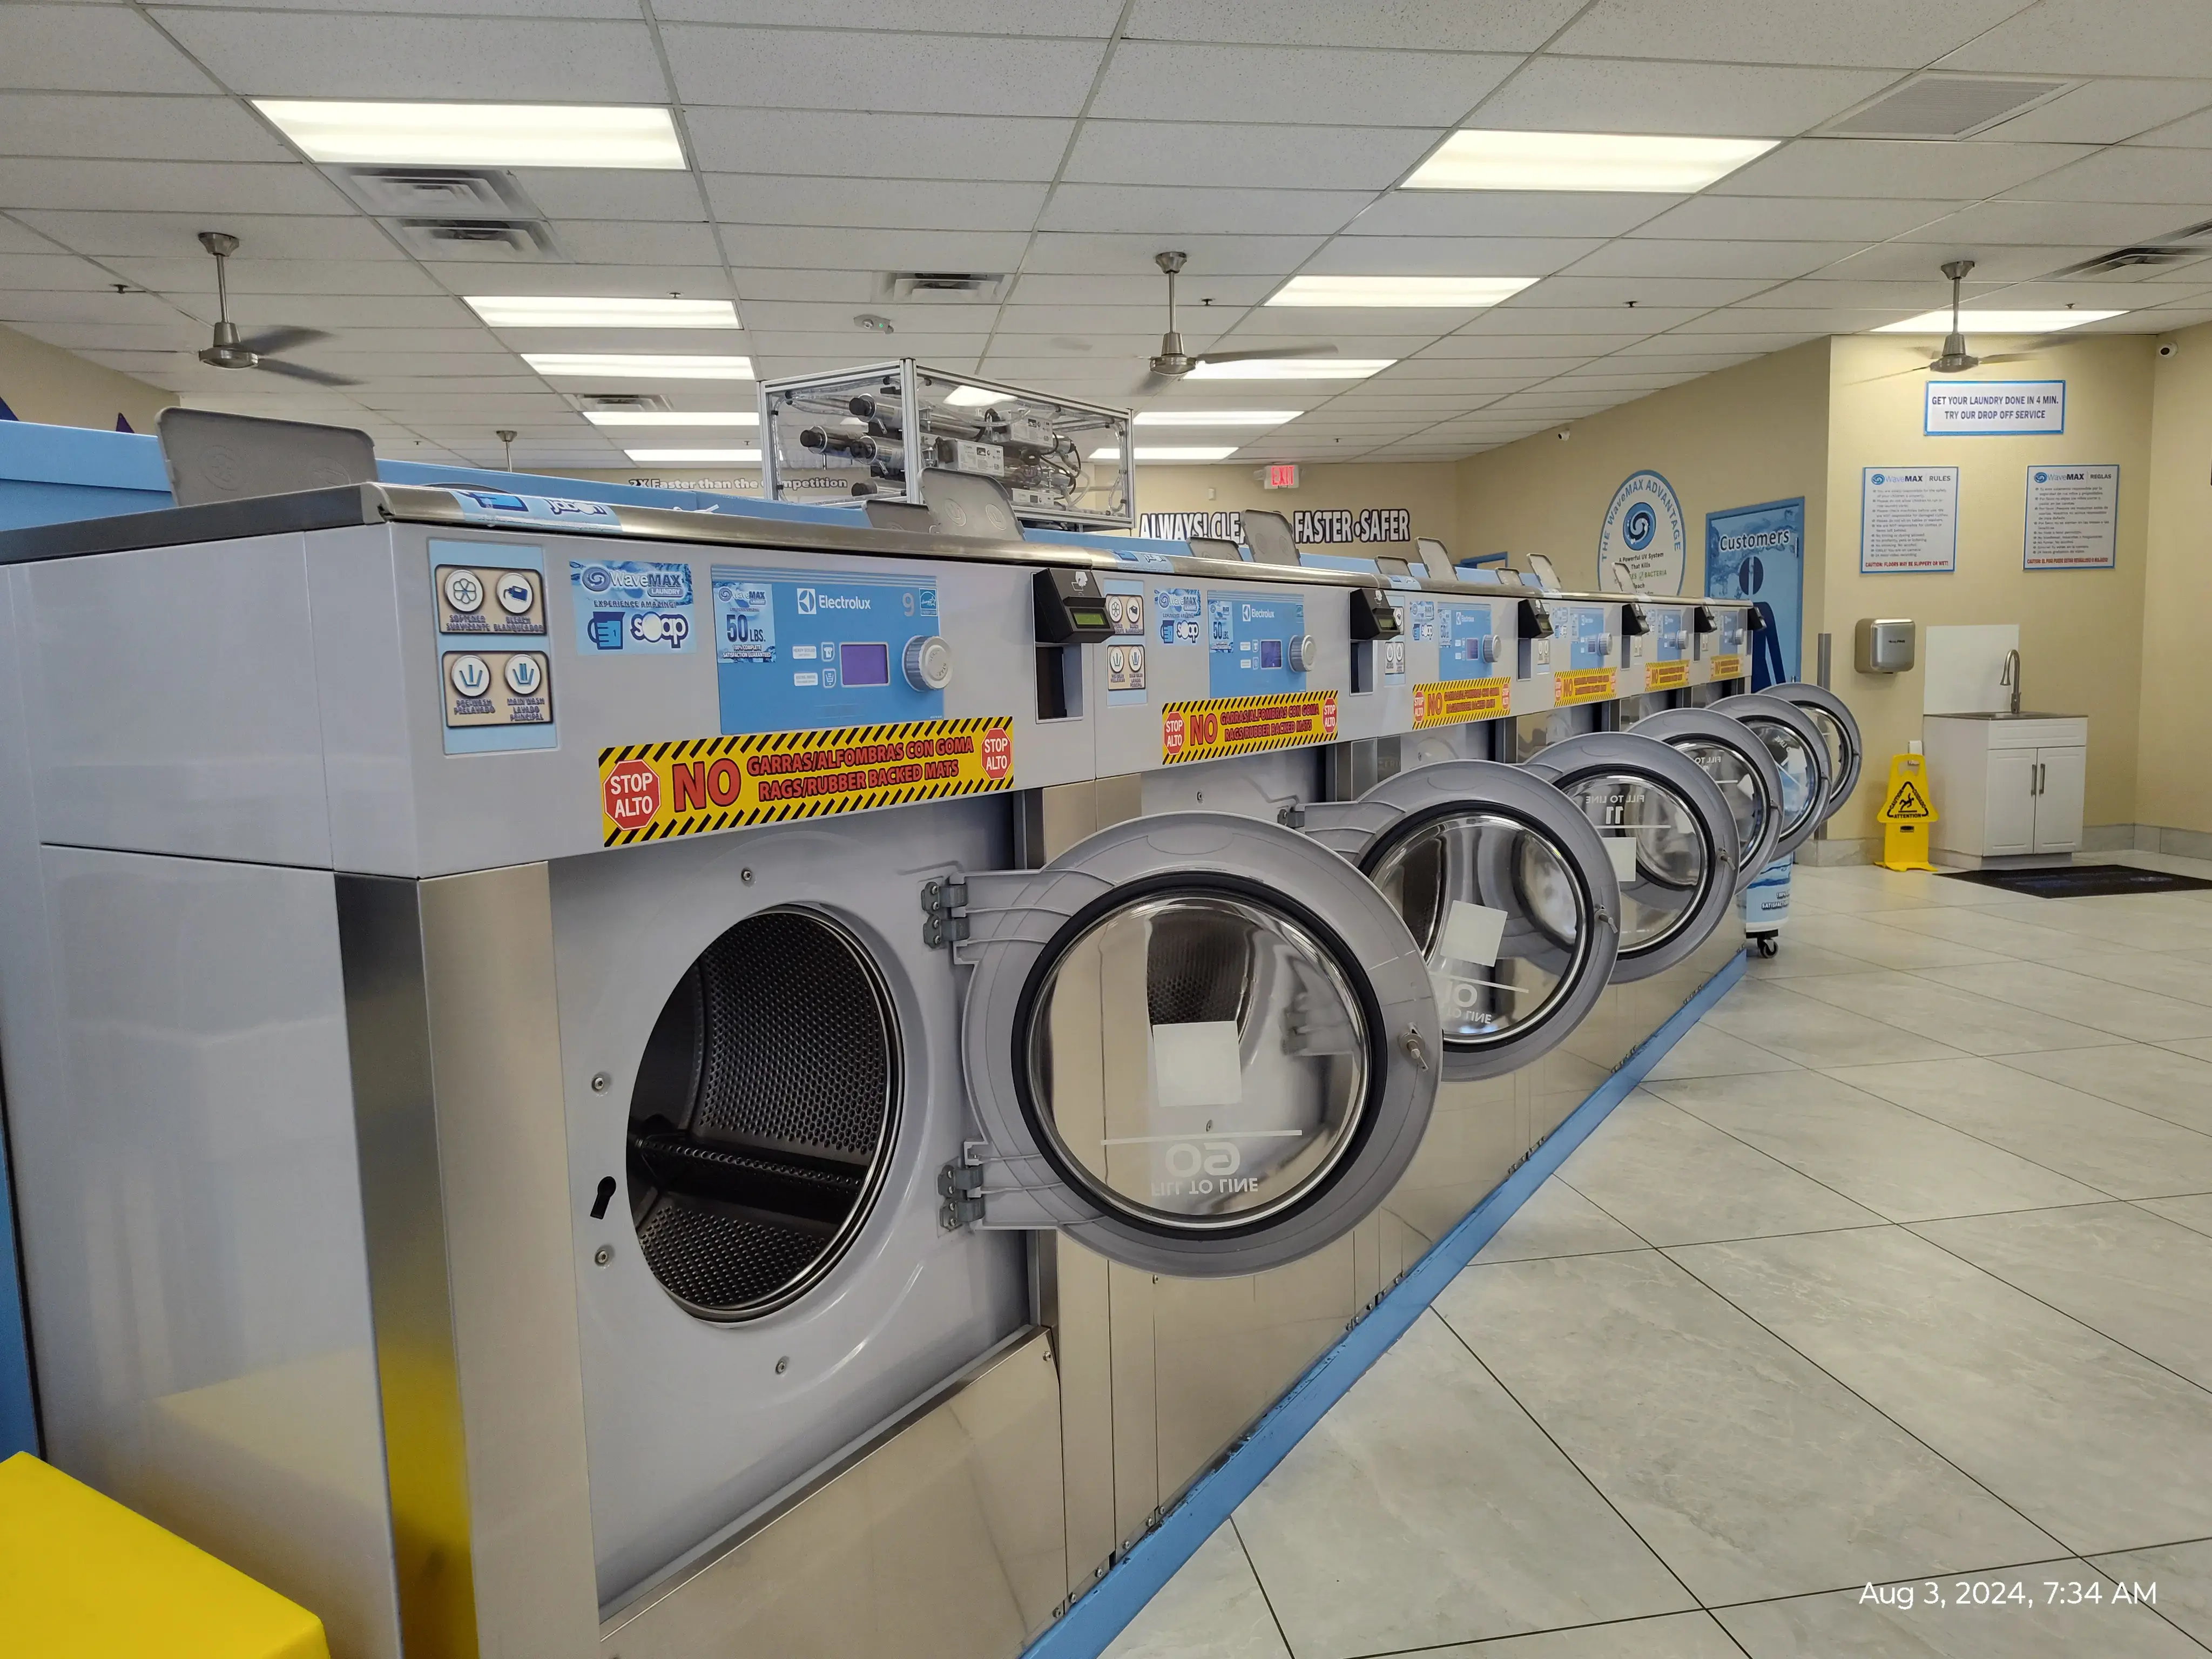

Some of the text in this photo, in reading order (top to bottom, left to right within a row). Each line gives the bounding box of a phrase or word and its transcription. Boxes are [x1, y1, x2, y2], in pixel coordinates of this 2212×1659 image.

[1932, 396, 1946, 405] GET
[1948, 396, 1967, 405] YOUR
[1970, 396, 2003, 404] LAUNDRY
[2005, 396, 2025, 404] DONE
[2027, 396, 2034, 404] IN
[2042, 395, 2059, 404] MIN.
[1945, 410, 2045, 420] TRY OUR DROP OFF SERVICE
[1271, 466, 1294, 486] EXIT
[2047, 473, 2085, 481] WaveMAX
[629, 477, 848, 491] 2X Faster than the mpetition
[1139, 512, 1209, 541] ALWAYS!
[1293, 509, 1411, 543] FASTER SAFER
[1602, 479, 1681, 561] THE WaveMAX ADVANTAGE
[1719, 529, 1790, 552] Customers
[609, 571, 682, 588] WaveMAX
[1644, 570, 1667, 578] BACTERIA
[594, 600, 677, 609] EXPERIENCE AMAZING!
[818, 595, 871, 611] Electrolux
[902, 592, 915, 617] 9
[449, 614, 486, 623] SOFTENER
[1251, 608, 1275, 618] Electrolux
[446, 623, 490, 631] SUAVIZANTE
[493, 624, 544, 633] BLANQUEADOR
[726, 614, 766, 643] 50 LBS.
[1213, 621, 1222, 639] 50
[507, 697, 525, 705] MAIN
[1414, 697, 1424, 706] STOP
[1427, 692, 1442, 717] NO
[454, 706, 496, 715] PRELAVADO
[509, 713, 544, 721] PRINCIPAL
[512, 706, 540, 714] LAVADO
[1220, 703, 1320, 725] GARRAS/ALFOMBRAS CON GOMA
[1324, 705, 1336, 716] STOP
[1415, 707, 1424, 716] ALTO
[1166, 719, 1183, 733] STOP
[1190, 713, 1218, 746] NO
[1324, 718, 1336, 727] ALTO
[1224, 719, 1313, 742] RAGS/RUBBER BACKED MATS
[984, 738, 1008, 753] STOP
[1166, 734, 1182, 747] ALTO
[746, 736, 974, 777] GARRAS/ALFOMBRAS CON GOMA
[986, 756, 1007, 771] ALTO
[610, 772, 653, 795] STOP
[672, 758, 741, 813] NO
[758, 759, 959, 802] RAGS/RUBBER BACKED MATS
[614, 795, 653, 819] ALTO
